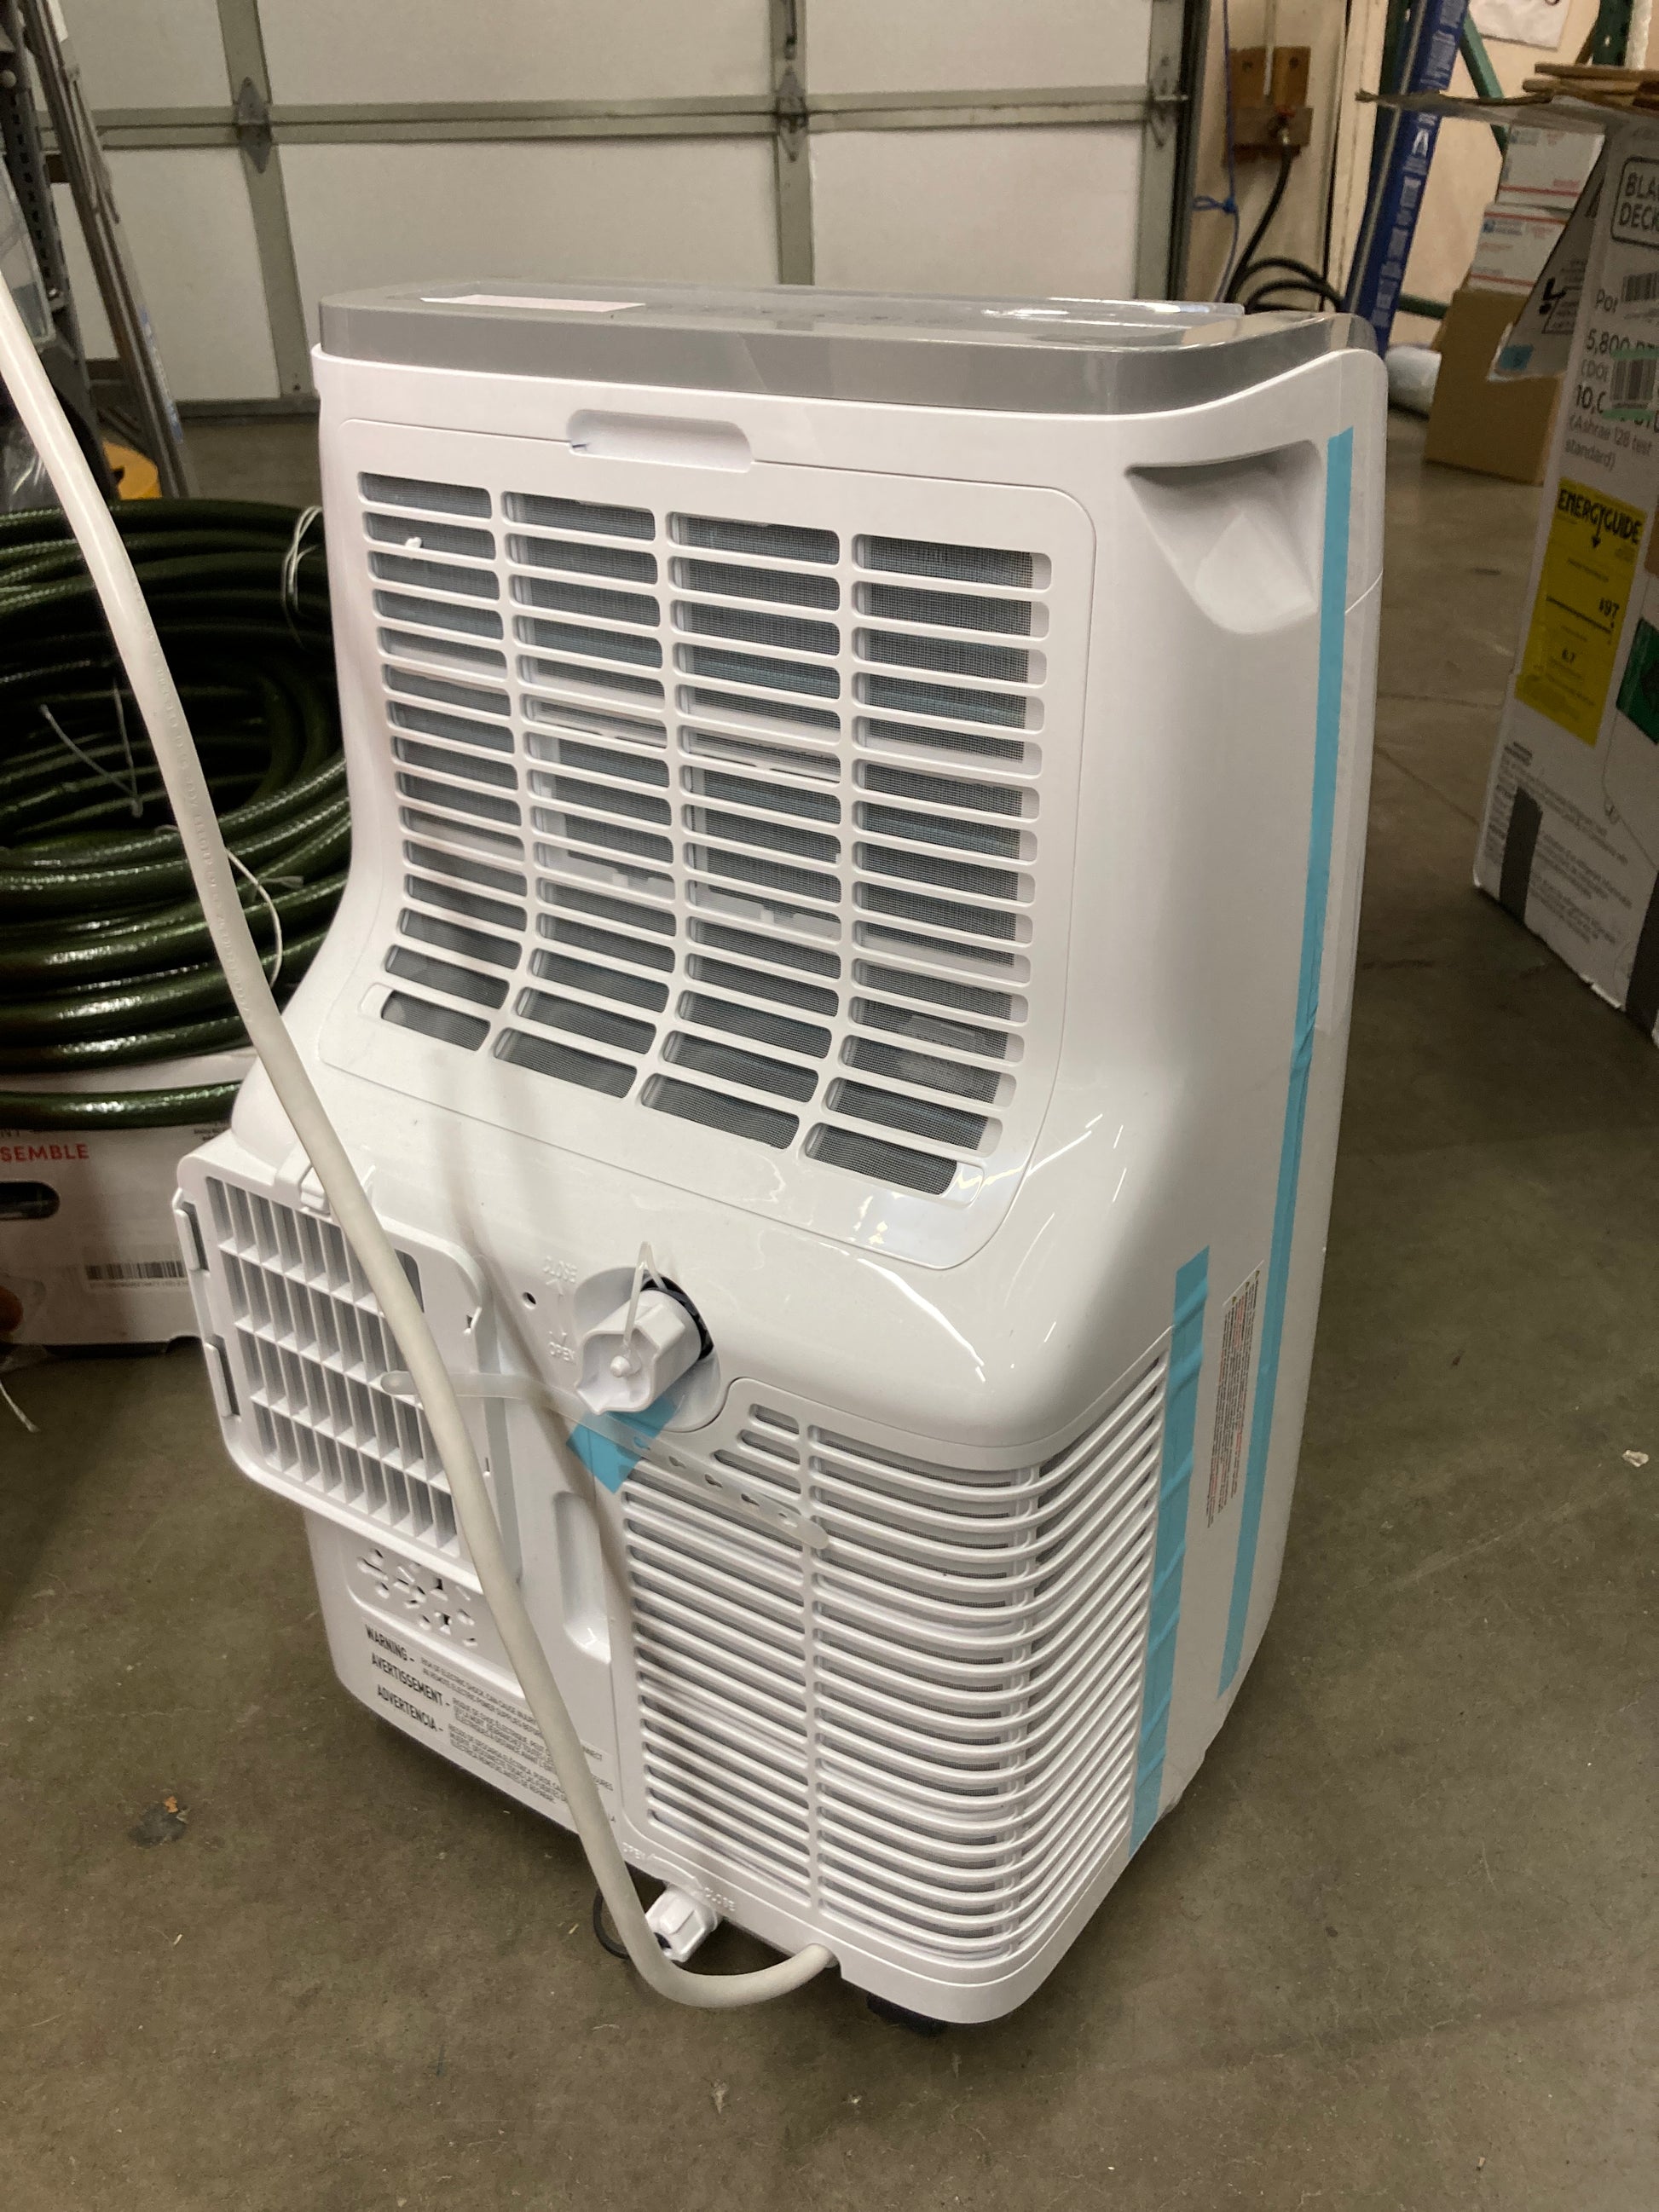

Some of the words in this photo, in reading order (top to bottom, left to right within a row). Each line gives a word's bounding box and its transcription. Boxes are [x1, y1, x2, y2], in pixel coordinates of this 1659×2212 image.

[1625, 172, 1659, 201] BLA
[365, 1624, 408, 1661] WARNING
[372, 1652, 443, 1706] AVERTISSEMENT
[377, 1684, 438, 1732] ADVERTENCIA
